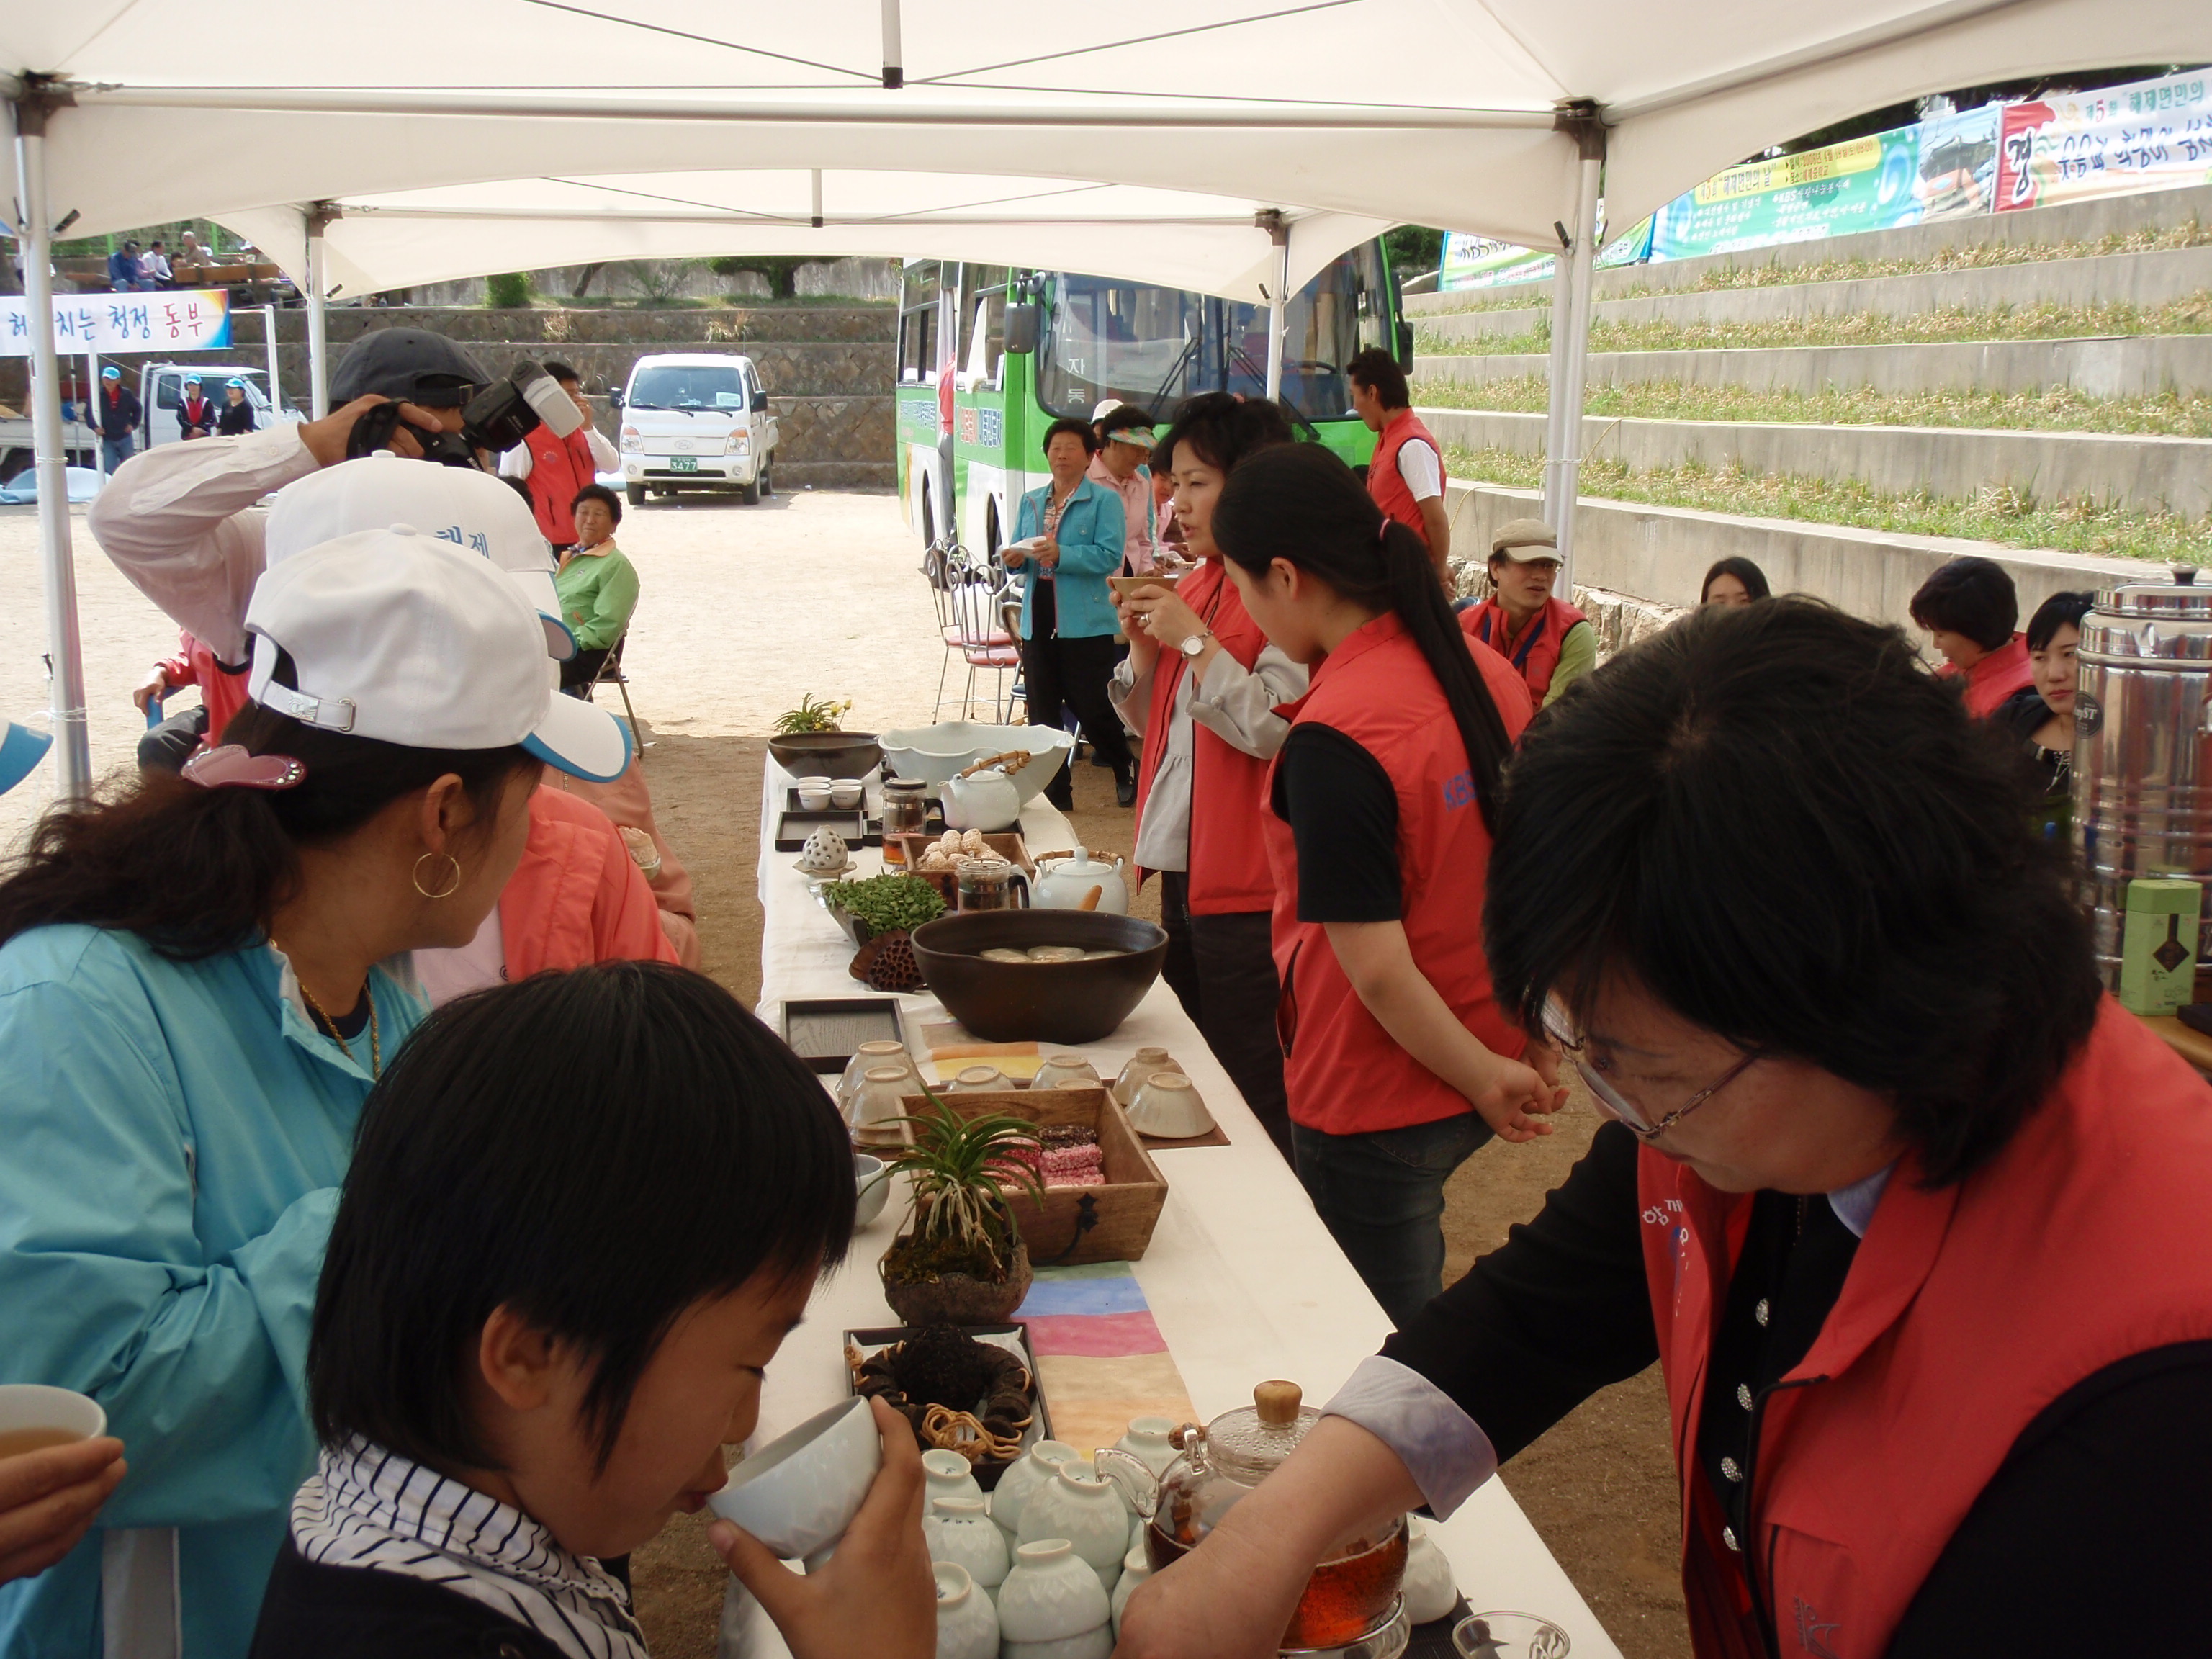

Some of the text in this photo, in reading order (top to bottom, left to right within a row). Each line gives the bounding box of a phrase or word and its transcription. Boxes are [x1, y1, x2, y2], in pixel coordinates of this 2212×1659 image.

[108, 304, 150, 339] 청정
[163, 302, 204, 339] 동부
[671, 462, 696, 471] 3477
